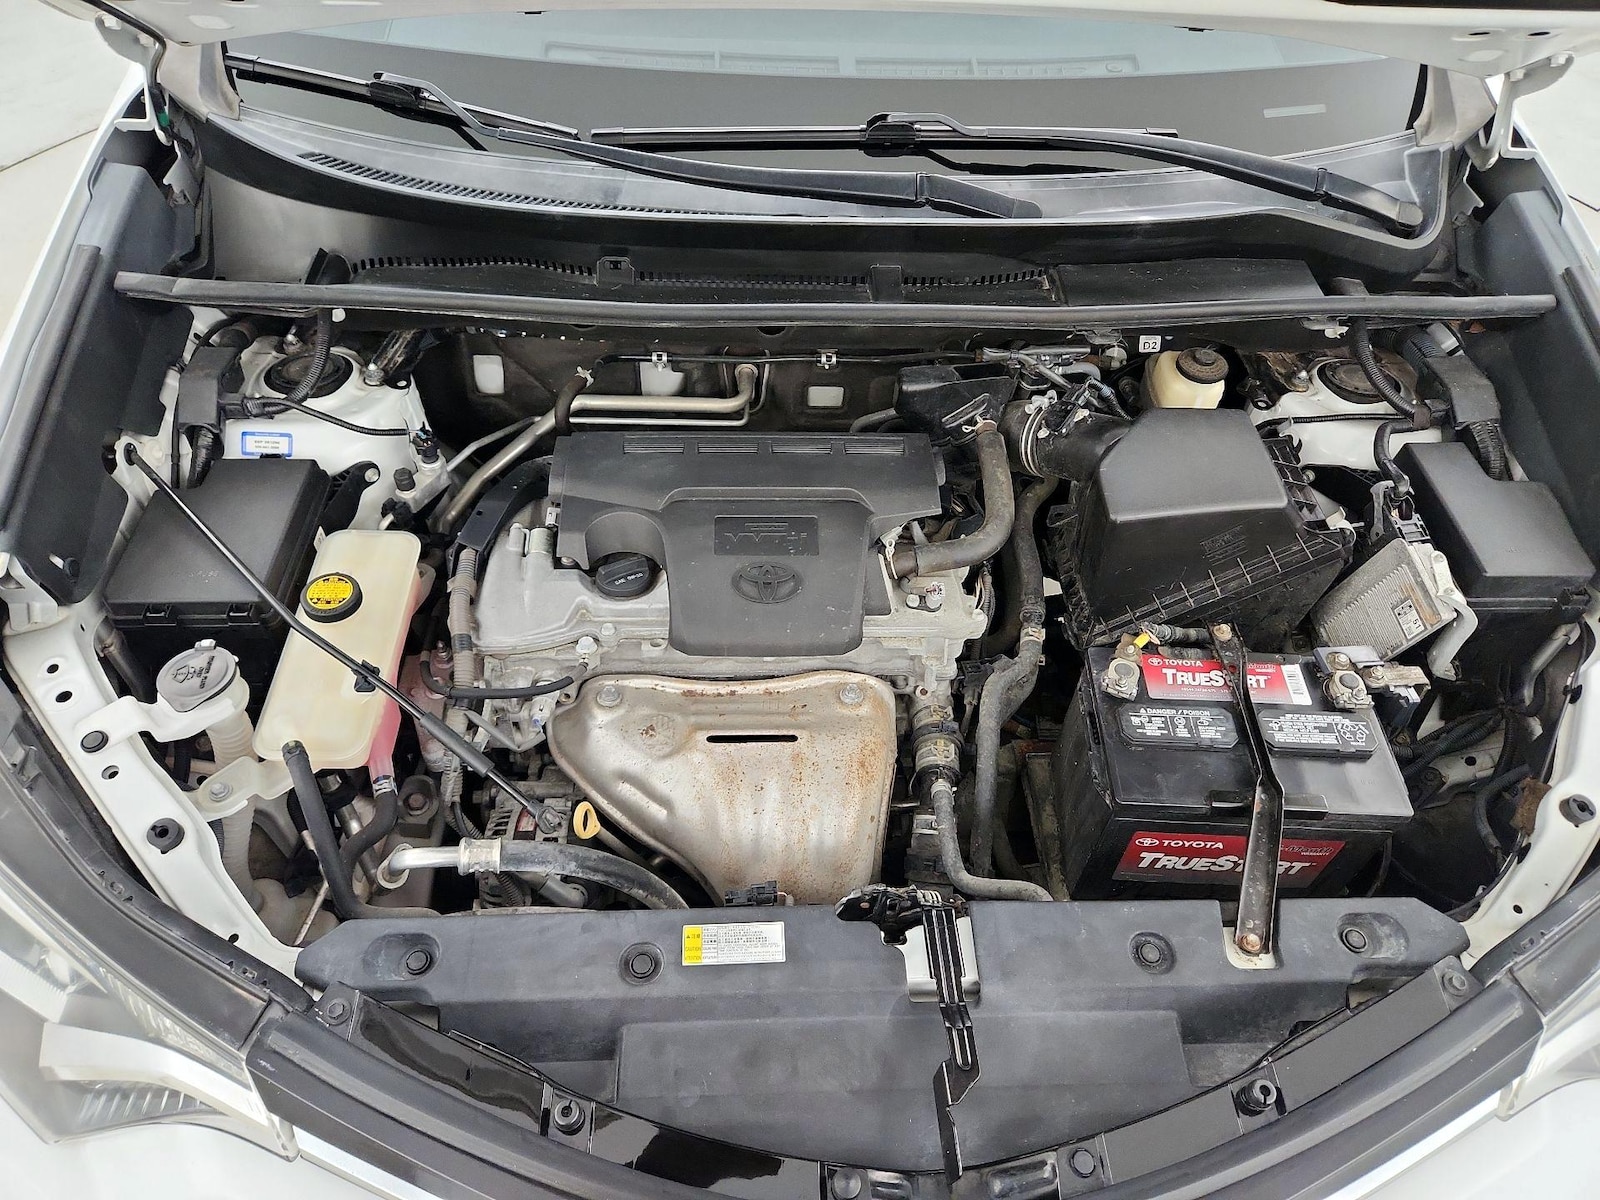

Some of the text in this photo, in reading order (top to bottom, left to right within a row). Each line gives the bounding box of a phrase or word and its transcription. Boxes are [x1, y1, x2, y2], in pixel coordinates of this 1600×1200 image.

[1143, 341, 1157, 350] D2
[1163, 658, 1203, 668] TOYOTA
[1147, 708, 1177, 716] DANGER
[1162, 839, 1224, 850] TOYOTA
